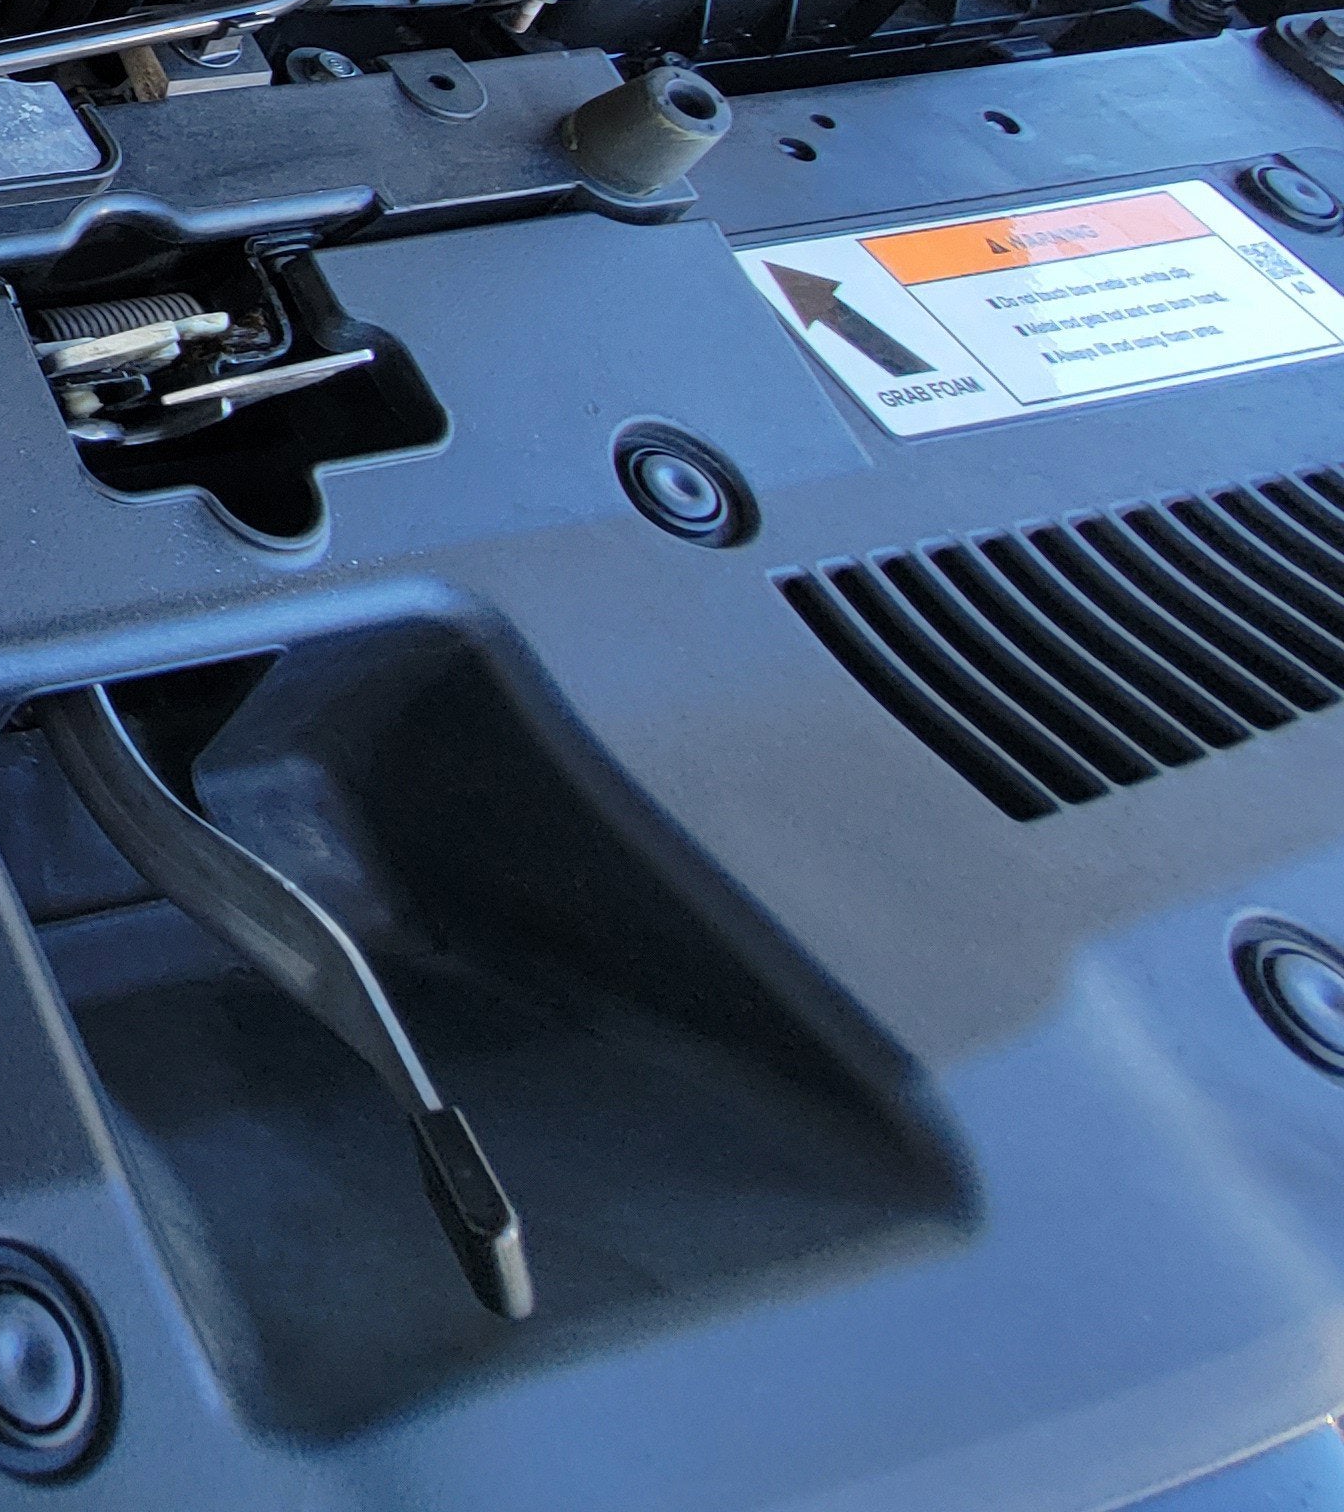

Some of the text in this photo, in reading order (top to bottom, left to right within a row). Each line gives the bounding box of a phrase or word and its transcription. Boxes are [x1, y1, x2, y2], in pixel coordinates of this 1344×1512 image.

[1006, 224, 1099, 250] WARNING
[877, 376, 986, 407] GRAB FOAM
